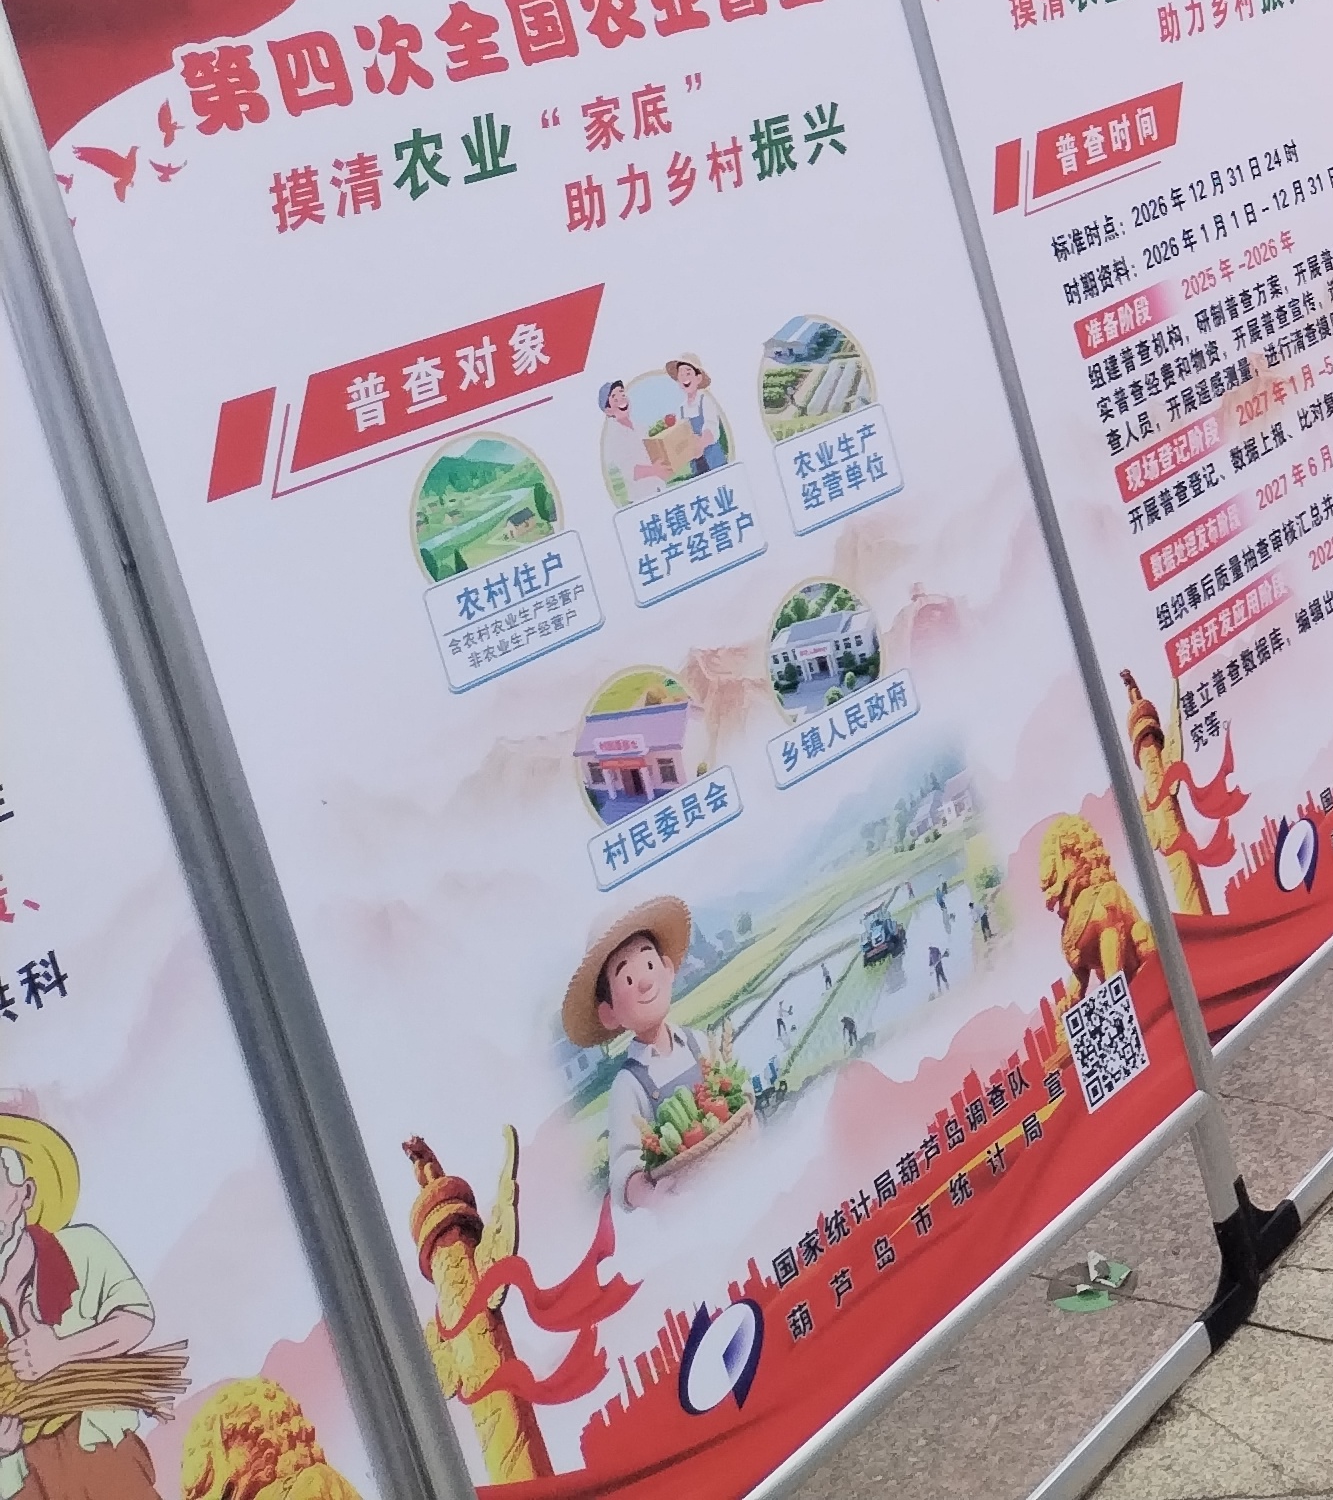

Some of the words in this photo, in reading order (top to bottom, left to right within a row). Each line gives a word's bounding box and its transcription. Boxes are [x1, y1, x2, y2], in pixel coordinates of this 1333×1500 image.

[564, 102, 848, 232] 助力乡村振兴
[1055, 104, 1160, 176] 普查时间
[1083, 296, 1154, 350] 准备阶段
[346, 321, 555, 434] 普查对象
[793, 425, 878, 479] 农业生产
[801, 452, 889, 510] 经营单位
[1124, 417, 1221, 493] 现场登记阶段
[638, 512, 756, 586] 生产经营户
[639, 485, 736, 547] 城镇农业
[447, 584, 585, 656] 含农村农业生产经营户
[456, 552, 564, 620] 农村住户
[467, 609, 578, 668] 非农业生产经营户
[782, 681, 909, 772] 乡镇人民政府
[604, 782, 730, 870] 村民委员会
[772, 1066, 1030, 1288] 国家统计局葫芦岛调查队
[1043, 1069, 1066, 1104] 宣
[786, 1112, 1044, 1342] 葫芦岛市统计局
